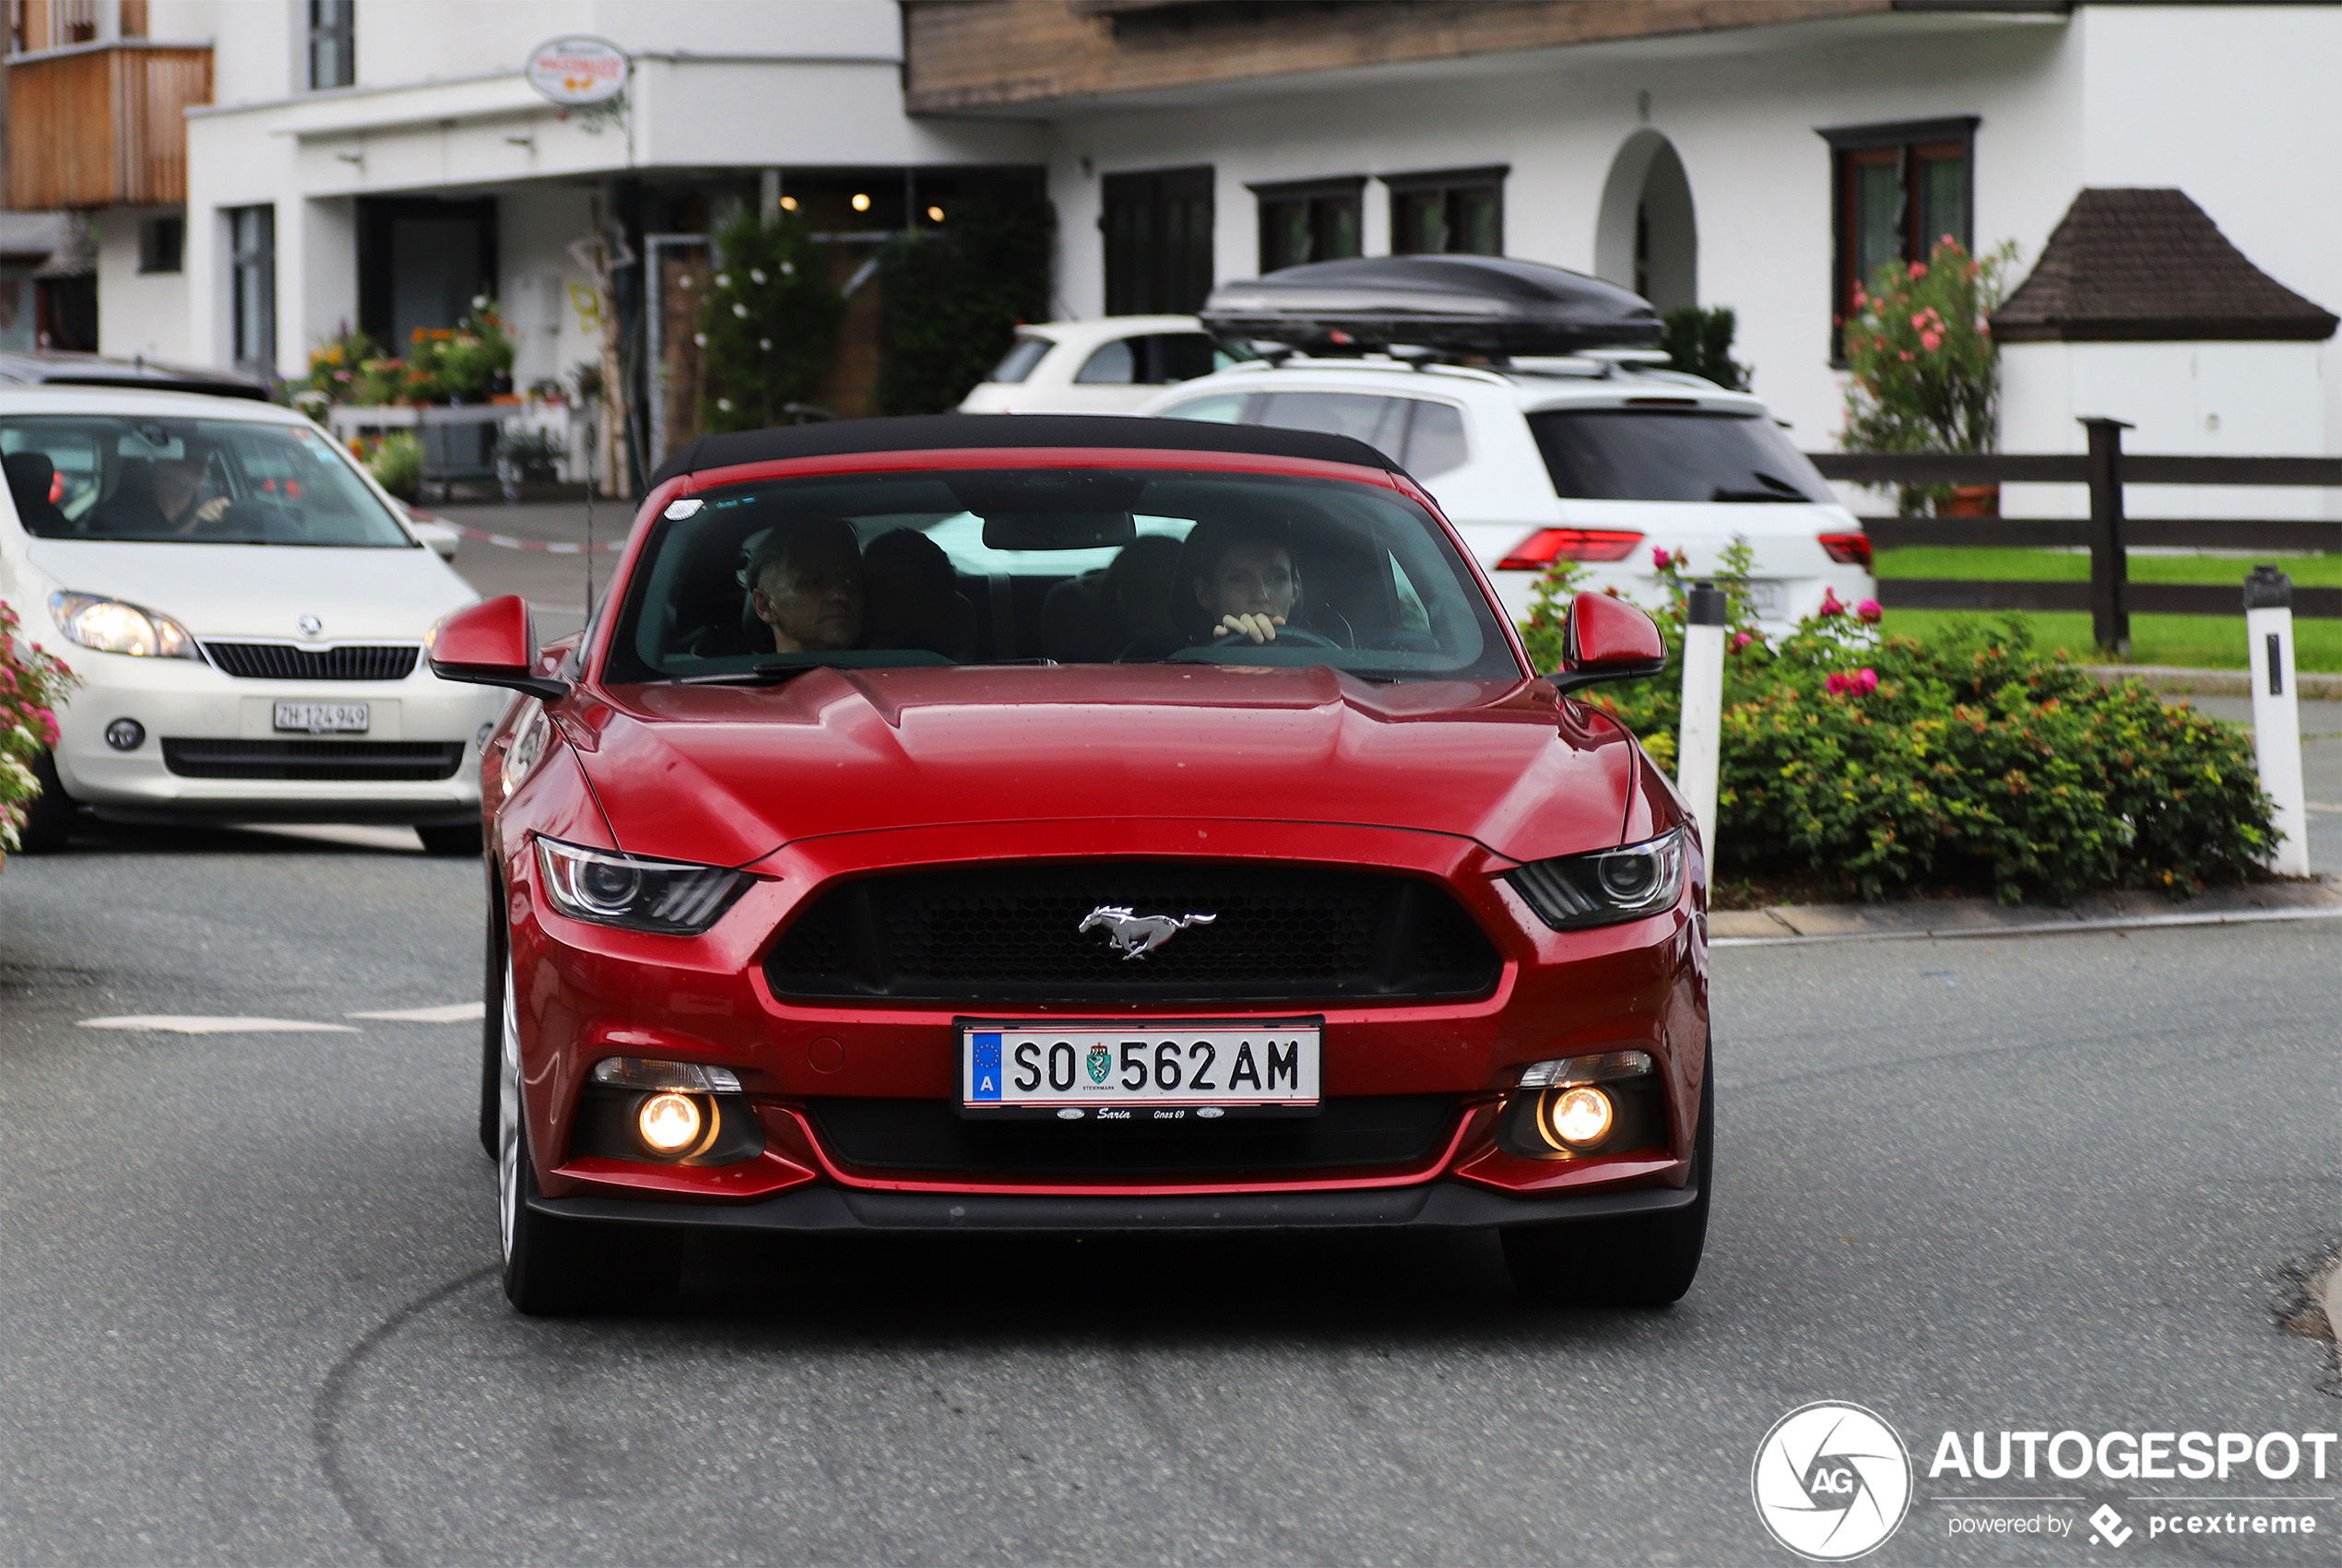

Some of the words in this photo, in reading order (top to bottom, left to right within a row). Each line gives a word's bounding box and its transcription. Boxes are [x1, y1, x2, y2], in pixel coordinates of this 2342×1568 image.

[279, 706, 299, 725] ZH
[1014, 1042, 1076, 1091] SO
[980, 1076, 994, 1091] A
[1096, 1106, 1132, 1120] Saria
[1153, 1110, 1174, 1120] Gnas
[1175, 1110, 1185, 1119] 69
